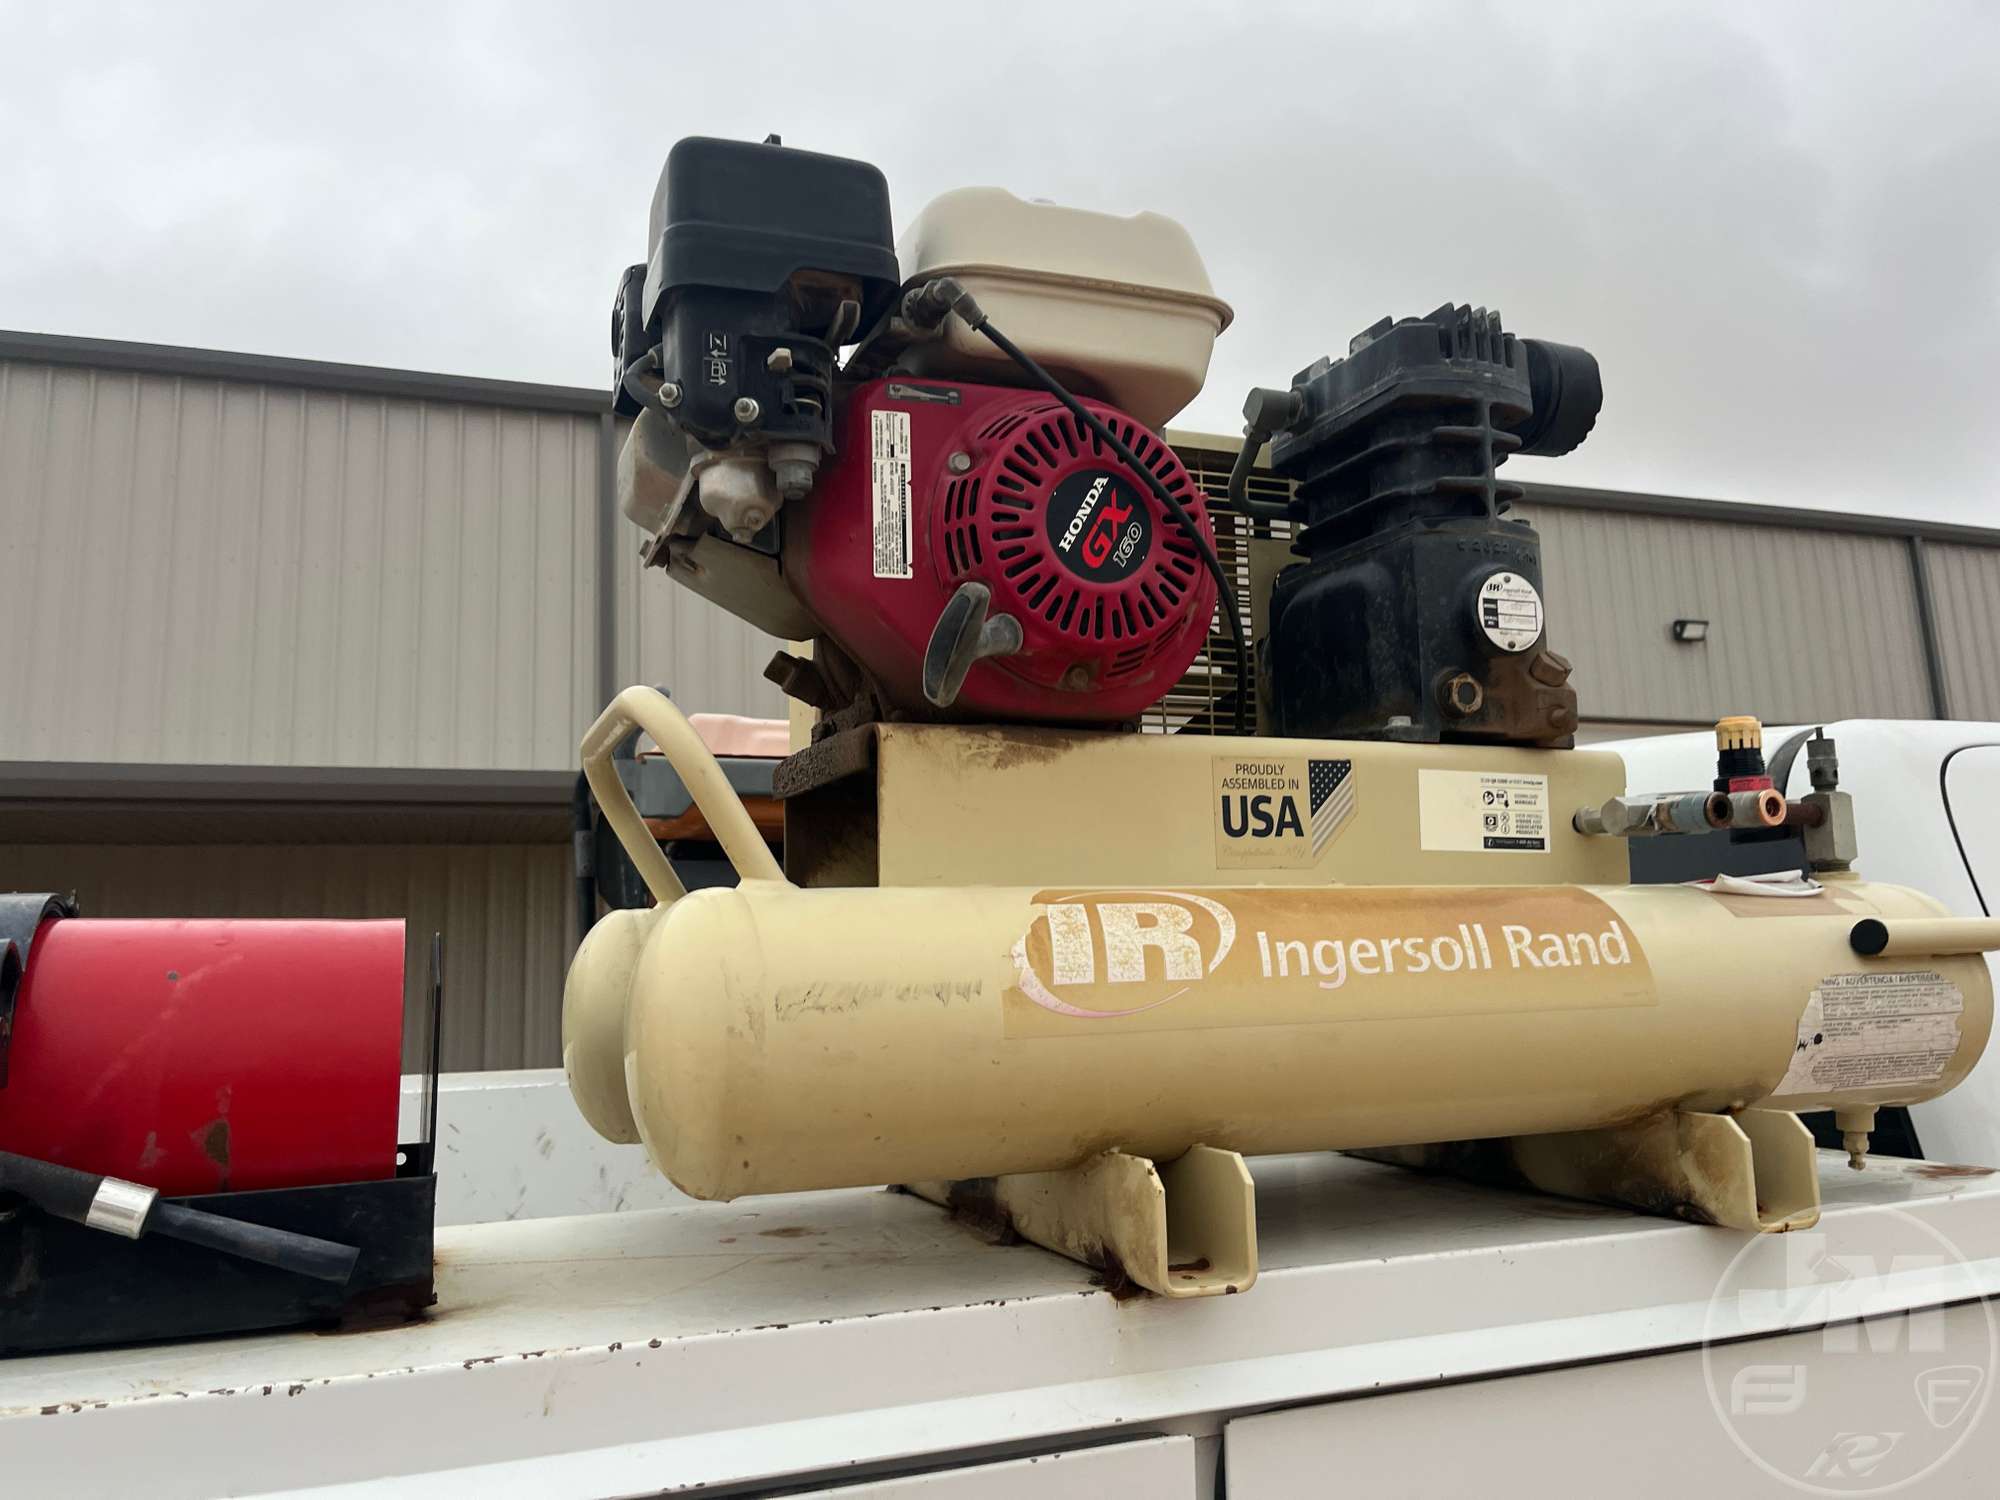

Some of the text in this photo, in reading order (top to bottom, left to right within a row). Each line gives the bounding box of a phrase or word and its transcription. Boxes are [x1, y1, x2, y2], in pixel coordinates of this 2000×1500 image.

[1058, 476, 1109, 553] HONDA
[1082, 487, 1133, 568] GX
[1112, 521, 1142, 568] 160
[1221, 777, 1300, 790] ASSEMBLED IN
[1235, 763, 1285, 776] PROUDLY
[1221, 794, 1304, 838] USA
[1047, 902, 1632, 989] IR Ingersoll Rand
